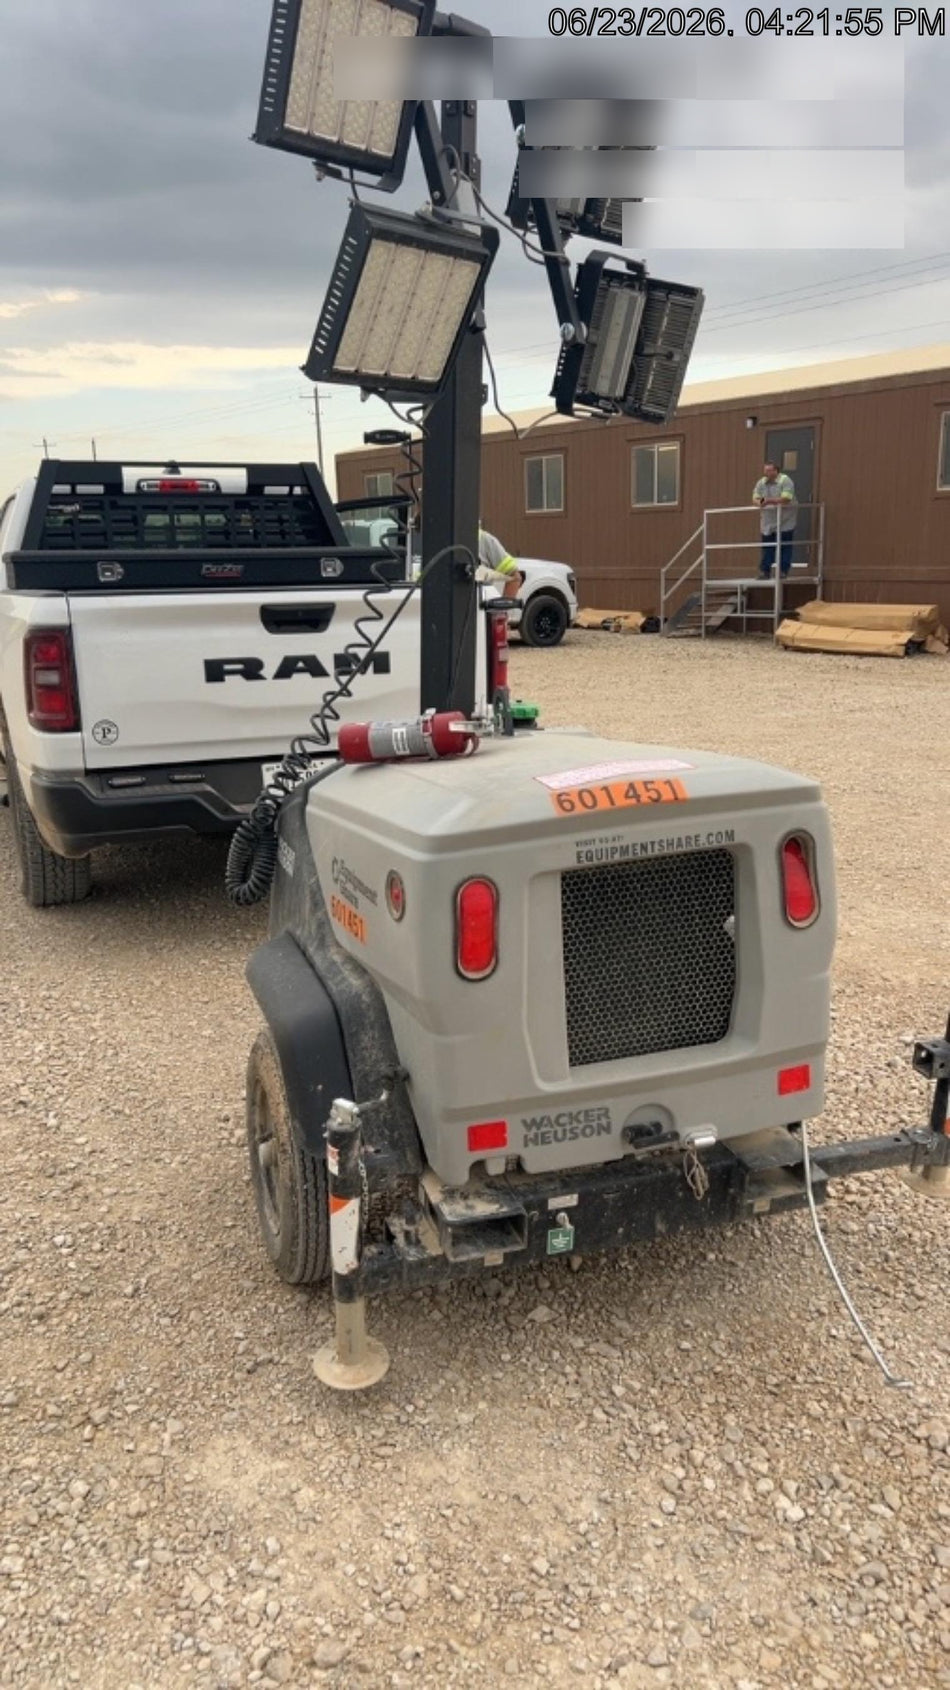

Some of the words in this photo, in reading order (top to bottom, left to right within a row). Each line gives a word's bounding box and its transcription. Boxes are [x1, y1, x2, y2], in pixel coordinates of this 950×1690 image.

[203, 651, 392, 684] RAM
[556, 779, 680, 813] 601451
[575, 829, 736, 865] EQUIPMENTSHARE.COM
[520, 1107, 612, 1133] WACKER
[523, 1121, 612, 1149] NEUSON
